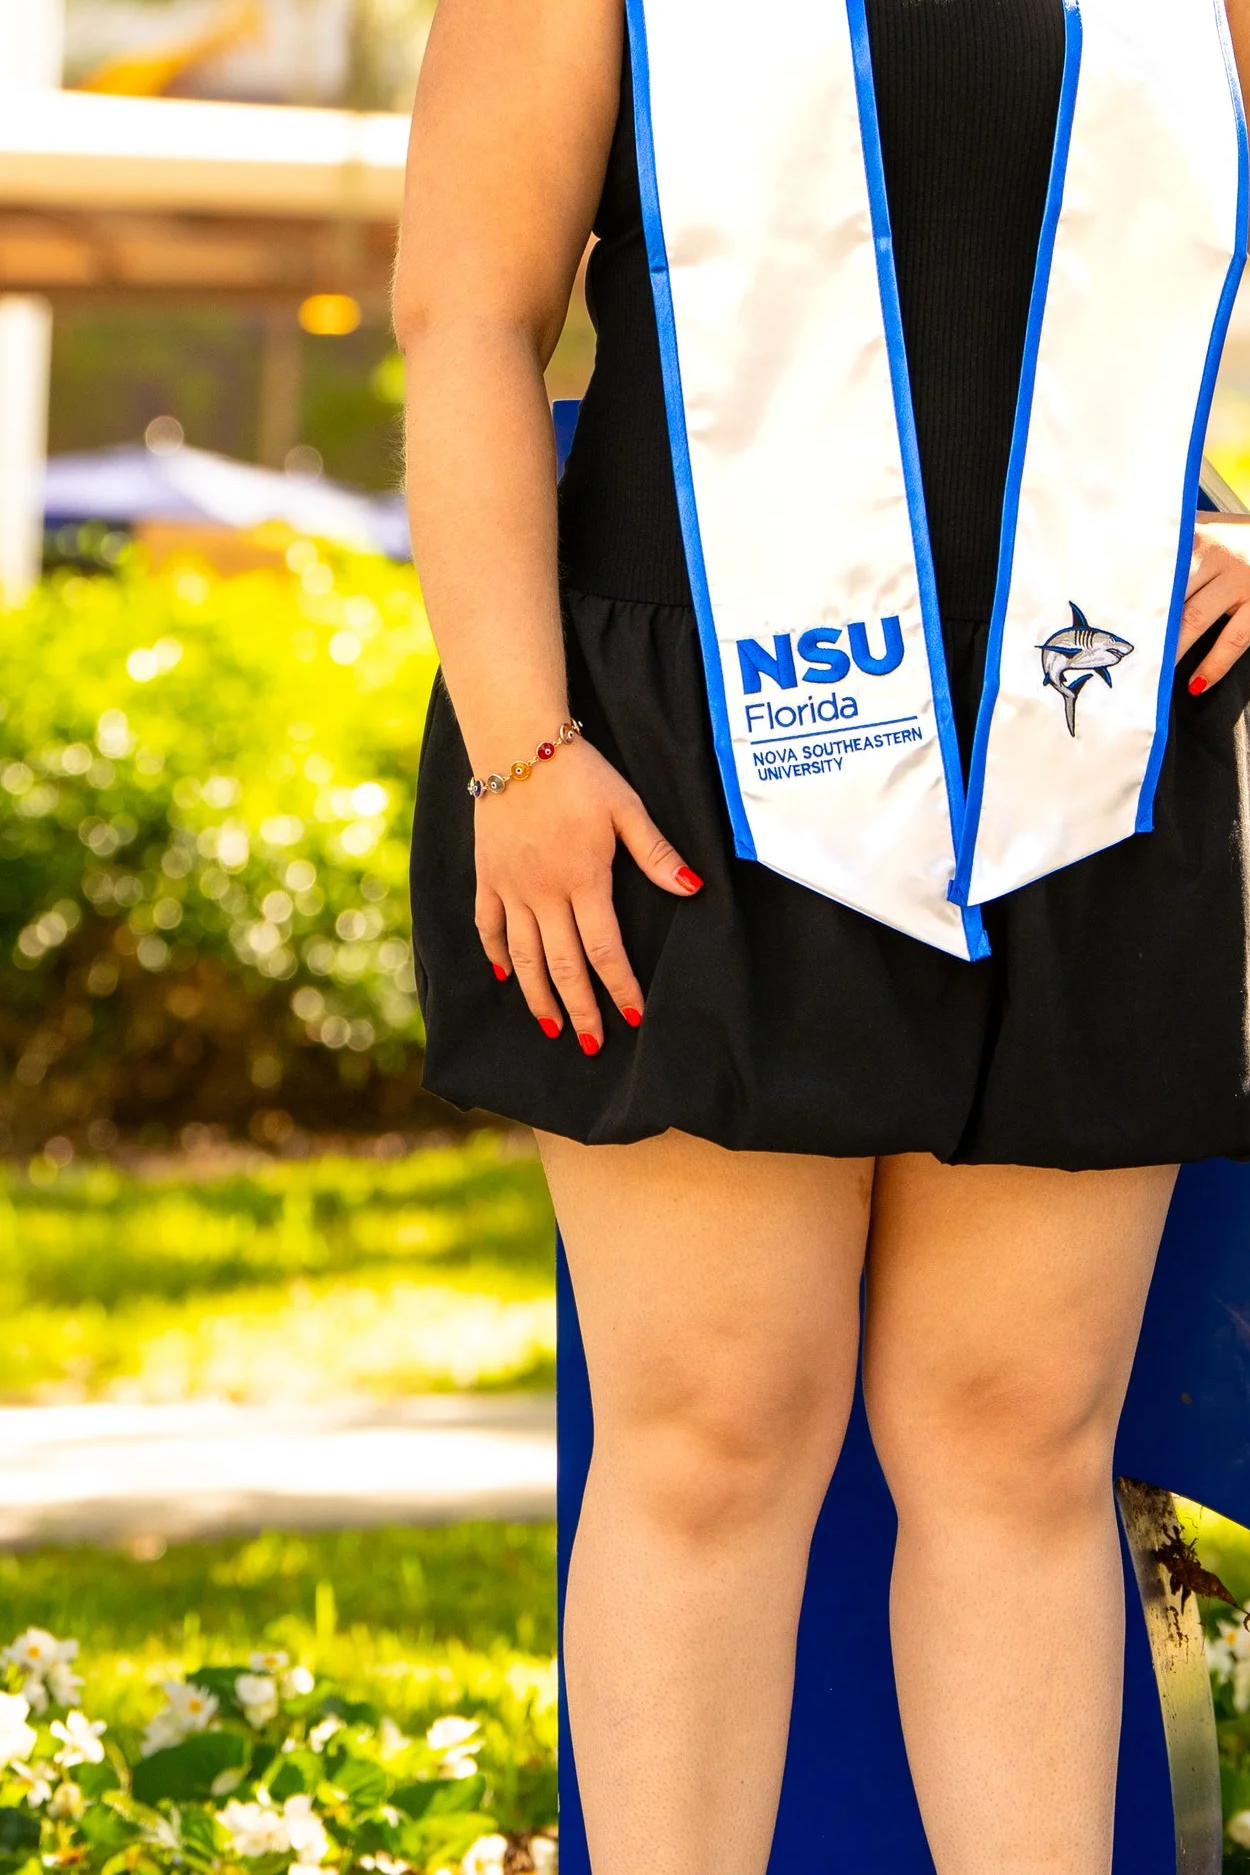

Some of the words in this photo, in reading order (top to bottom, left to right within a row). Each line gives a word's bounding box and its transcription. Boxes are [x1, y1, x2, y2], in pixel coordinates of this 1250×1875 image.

[736, 615, 905, 695] NSU
[745, 692, 859, 733] Florida
[753, 749, 798, 767] NOVA
[803, 727, 923, 759] SOUTHEASTERN
[758, 757, 844, 781] UNIVERSITY
